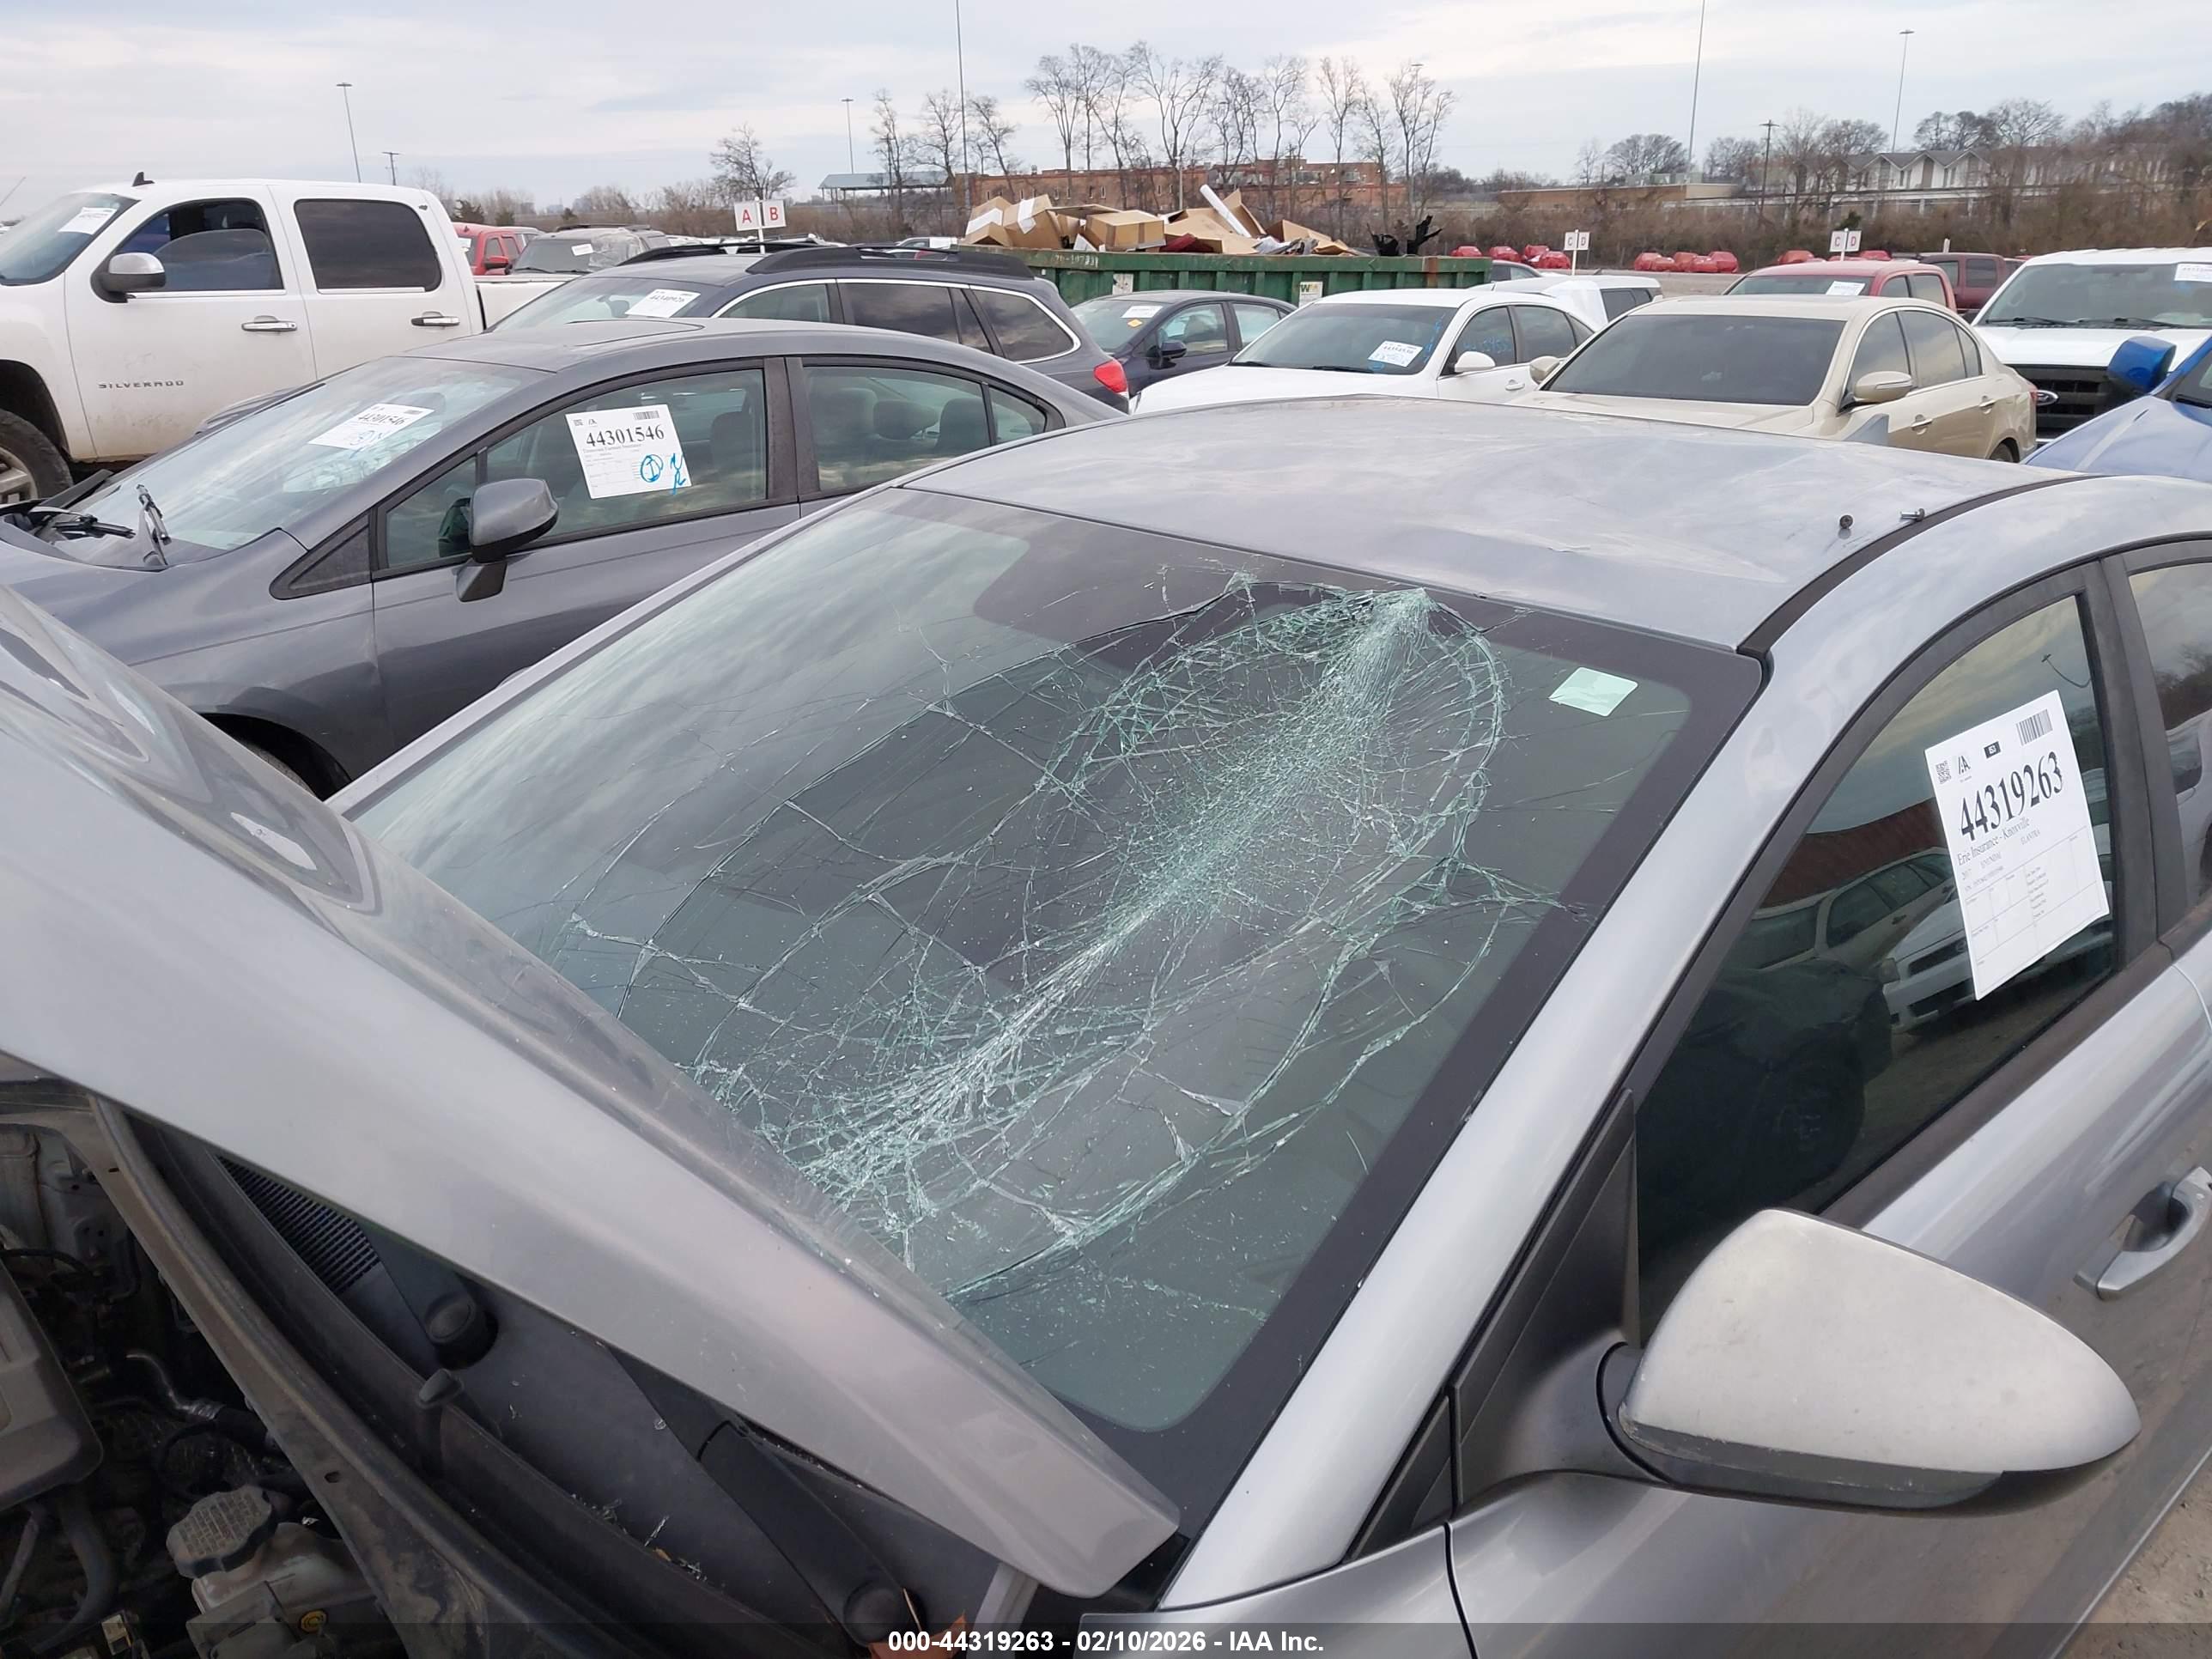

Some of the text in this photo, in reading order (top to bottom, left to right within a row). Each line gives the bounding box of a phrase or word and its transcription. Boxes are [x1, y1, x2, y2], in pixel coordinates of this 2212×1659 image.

[742, 206, 779, 224] A B
[1567, 236, 1587, 246] C D
[1834, 235, 1857, 247] C D
[98, 380, 185, 389] SILVERADO
[586, 424, 665, 447] 44301546
[1960, 750, 2063, 842] 44319263
[1957, 852, 1972, 866] Erie
[1971, 836, 1999, 859] Insurance
[2002, 816, 2030, 840] Knoxville
